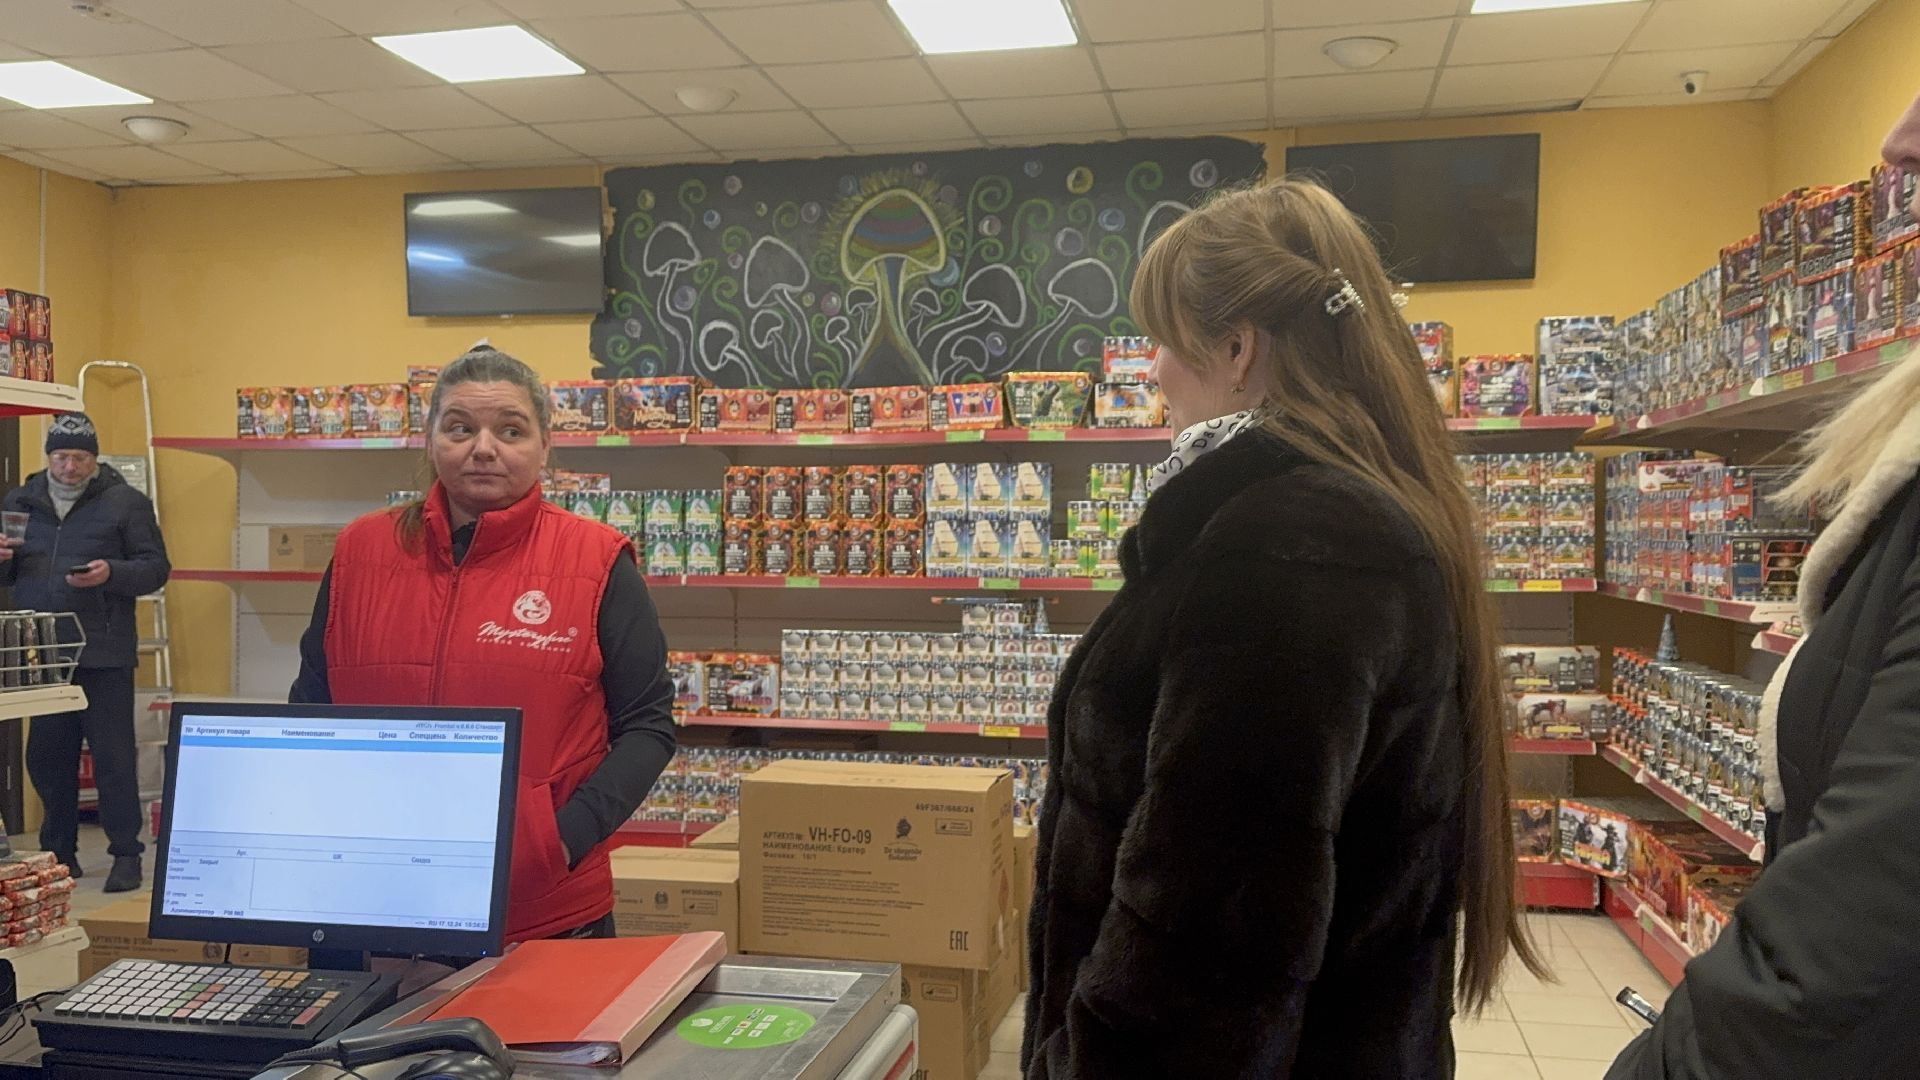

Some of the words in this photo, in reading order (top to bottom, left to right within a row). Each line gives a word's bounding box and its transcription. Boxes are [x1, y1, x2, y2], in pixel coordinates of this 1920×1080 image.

[196, 727, 225, 735] Артикул
[282, 729, 335, 737] Наименование
[378, 731, 397, 740] Цена
[409, 732, 446, 740] Спеццена
[454, 733, 498, 741] Количество
[763, 832, 795, 840] АРТИКУЛ
[809, 826, 872, 844] VH-FO-09
[763, 842, 834, 853] НАИМЕНОВАНИЕ:
[837, 846, 866, 855] Кратер
